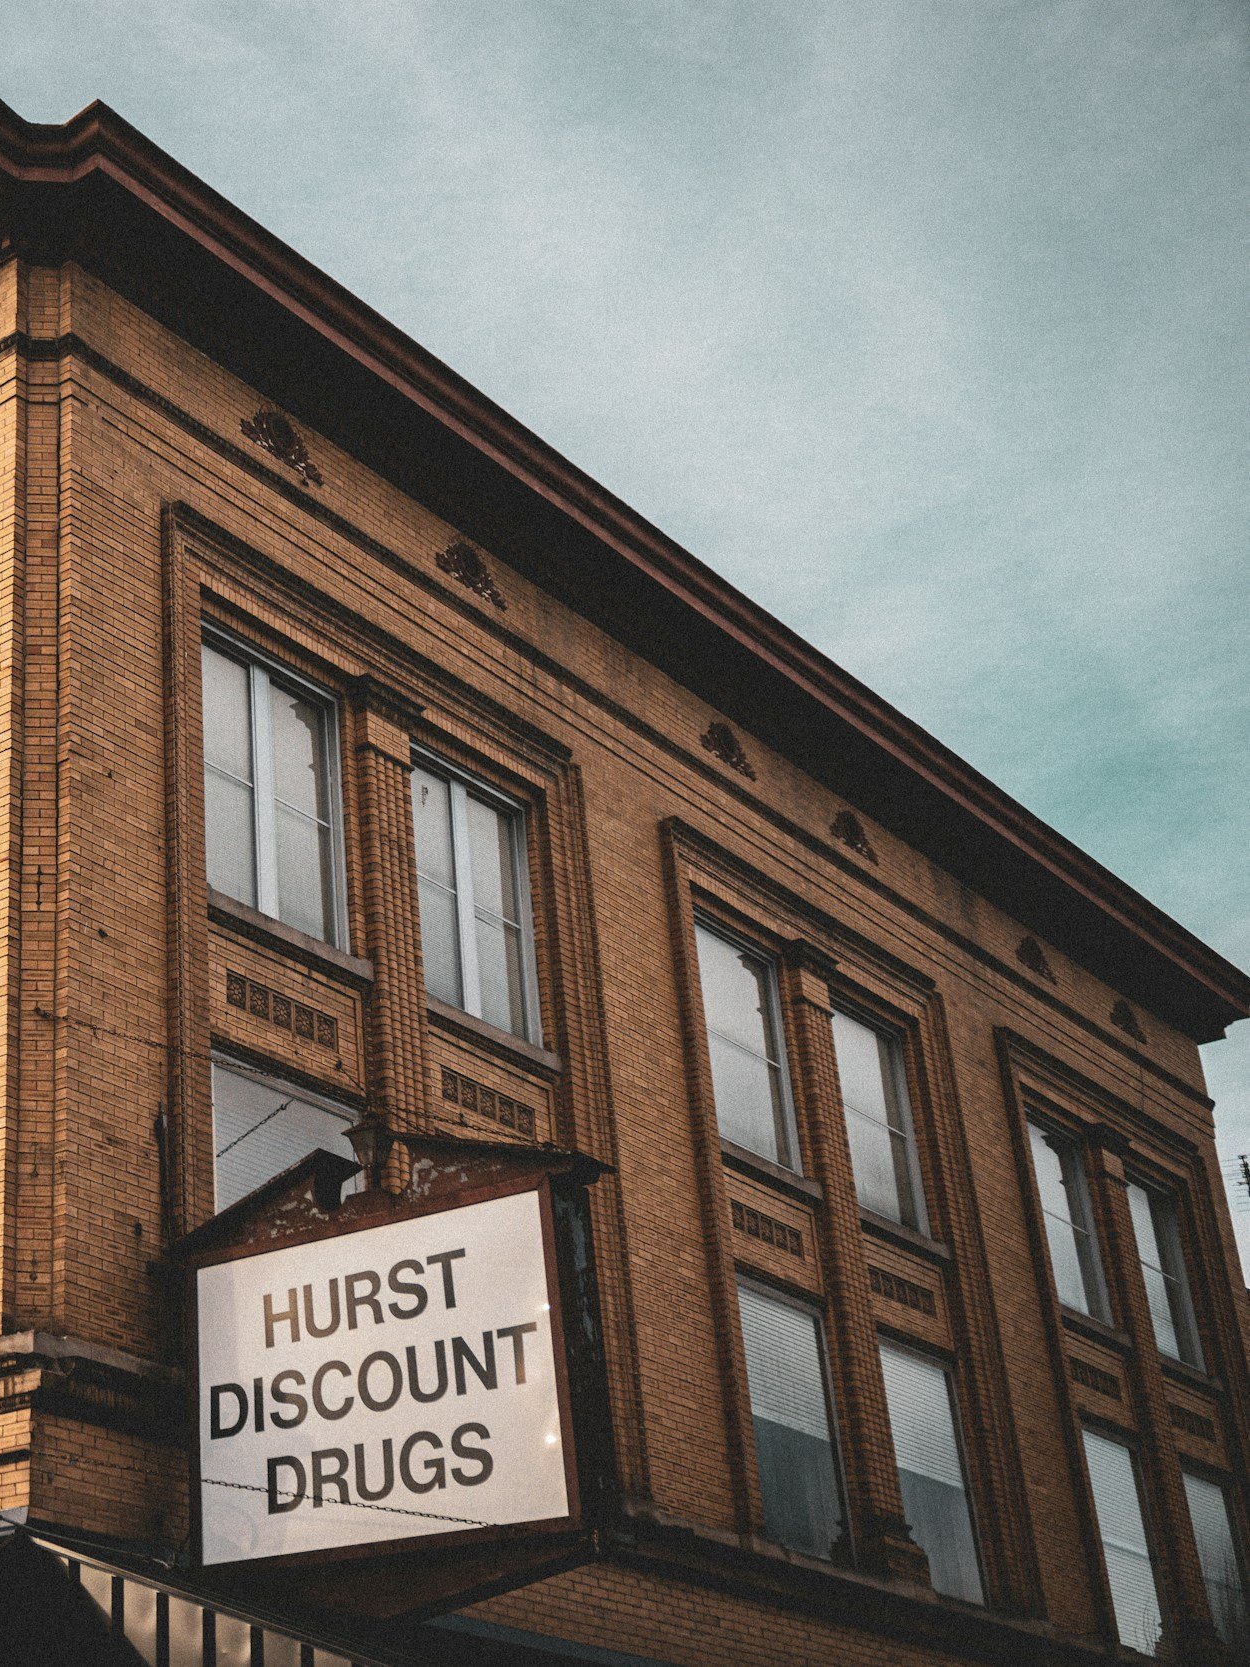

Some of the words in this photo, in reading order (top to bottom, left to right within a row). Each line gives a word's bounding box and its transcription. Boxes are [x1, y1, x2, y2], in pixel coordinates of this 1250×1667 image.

[262, 1248, 466, 1348] HURST
[209, 1322, 537, 1440] DISCOUNT
[266, 1422, 494, 1515] DRUGS
